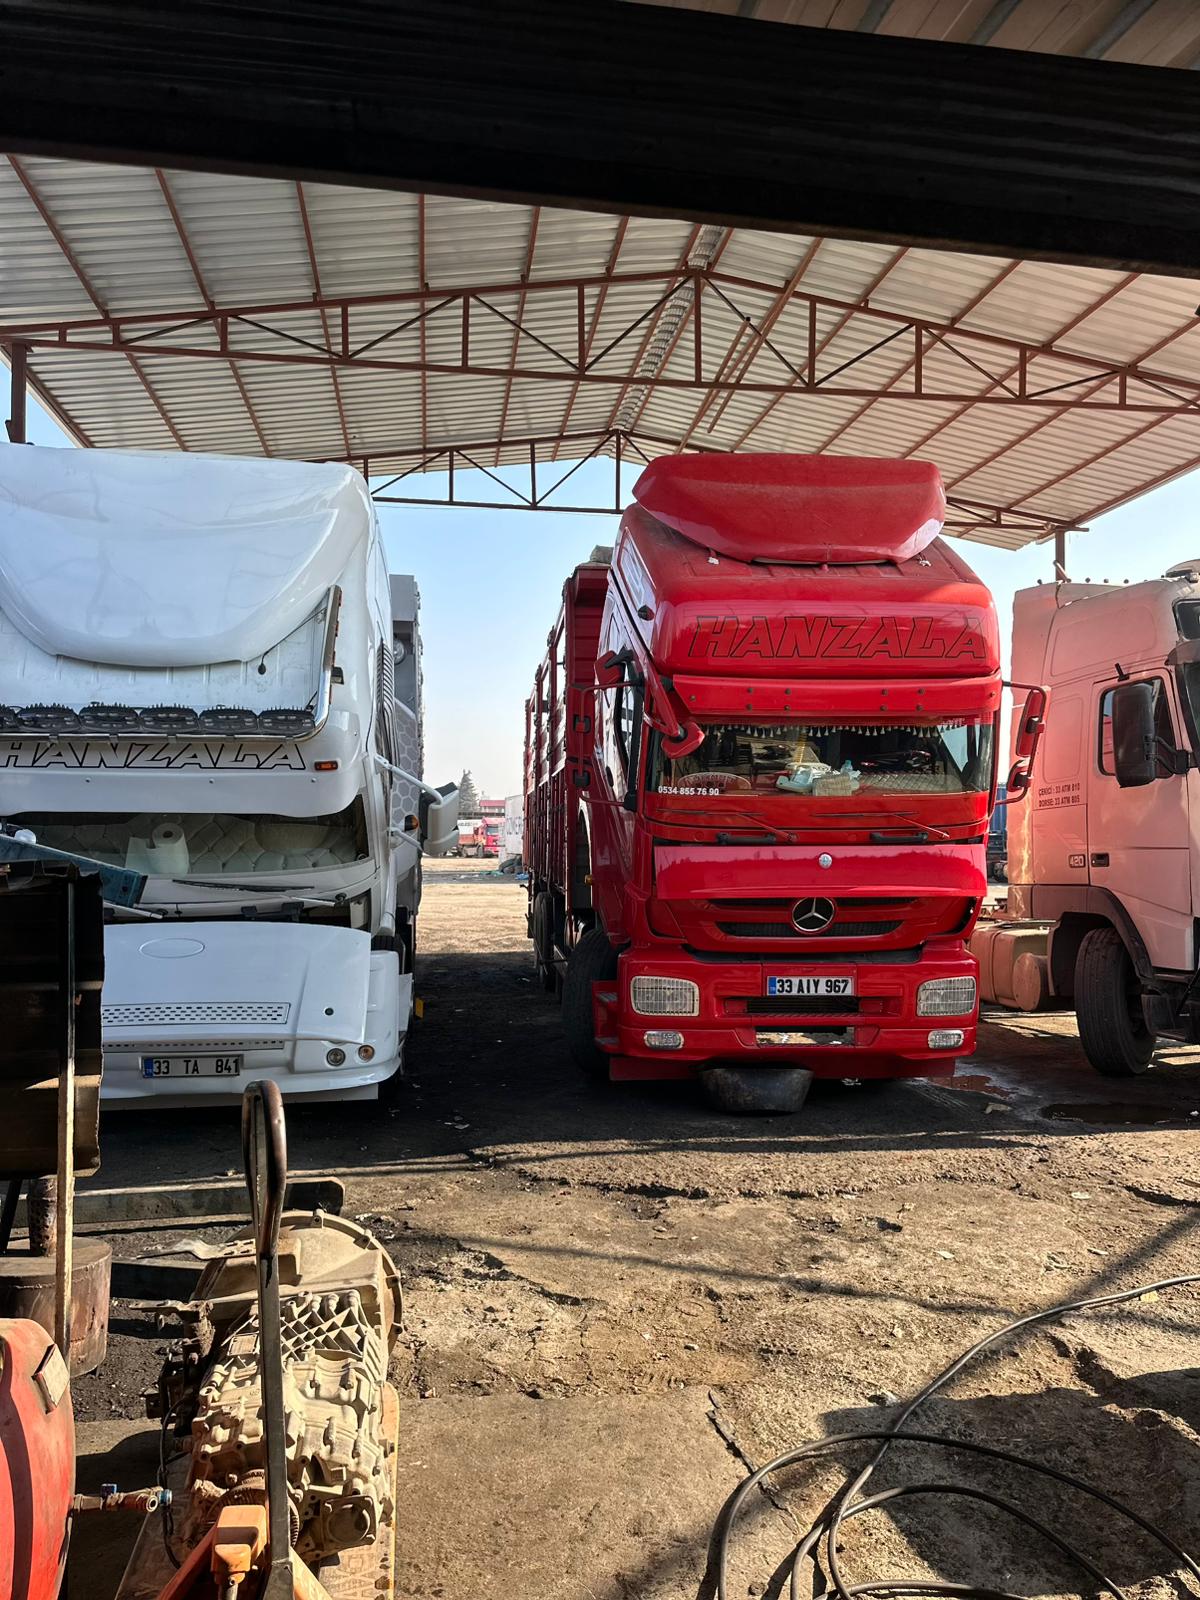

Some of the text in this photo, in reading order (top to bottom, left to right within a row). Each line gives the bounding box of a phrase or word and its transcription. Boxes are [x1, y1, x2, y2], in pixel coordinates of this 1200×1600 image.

[688, 615, 987, 658] HANZALA
[0, 741, 306, 770] HANZALA
[658, 785, 719, 796] 0534 855 76 90
[1069, 855, 1084, 867] 420
[777, 978, 793, 994] 33
[797, 978, 820, 994] AIY
[825, 978, 849, 994] 967
[153, 1060, 170, 1075] 33
[183, 1059, 200, 1074] TA
[215, 1058, 239, 1074] 841
